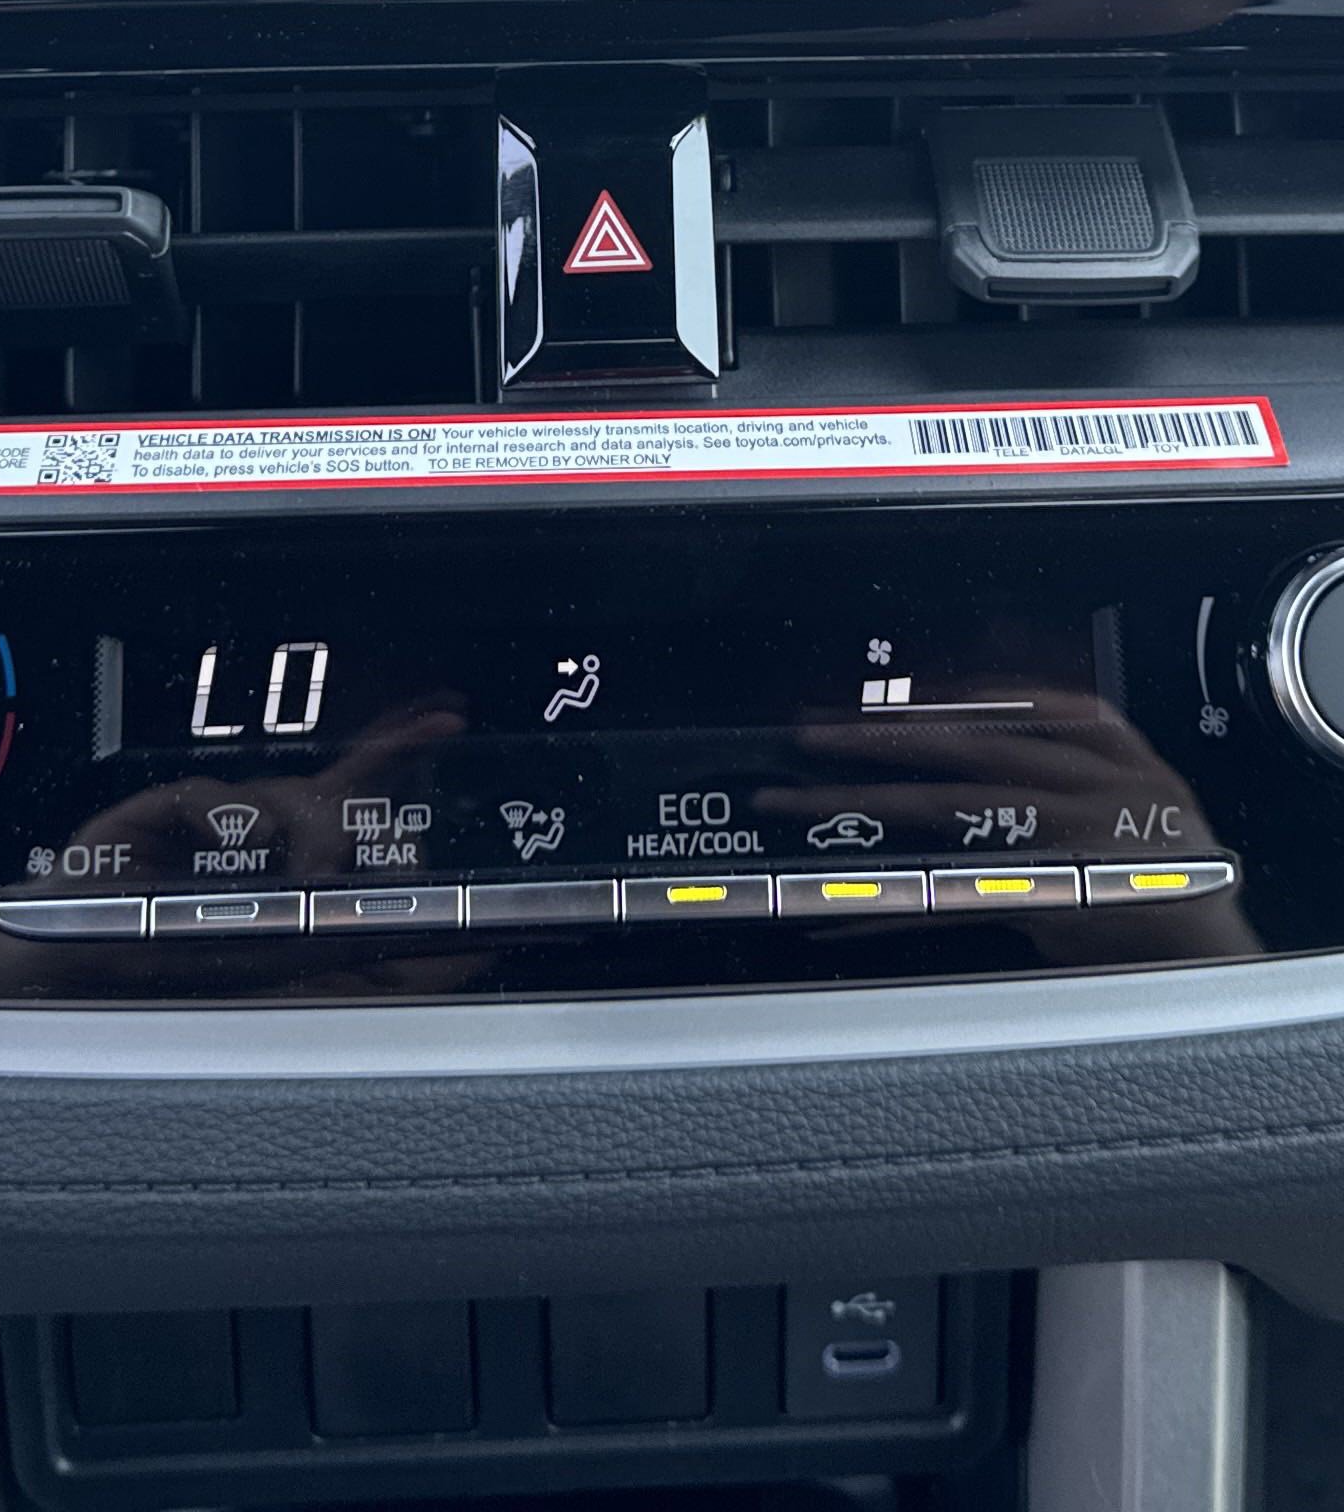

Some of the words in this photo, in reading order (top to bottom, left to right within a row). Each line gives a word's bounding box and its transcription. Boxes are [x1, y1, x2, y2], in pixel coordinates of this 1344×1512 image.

[138, 432, 208, 446] VEHICLE
[212, 431, 256, 444] DATA
[260, 428, 383, 443] TRANSMISSION
[388, 428, 403, 441] IS
[408, 427, 436, 441] ON!
[442, 428, 474, 439] Your
[478, 427, 527, 438] vehicle
[532, 425, 601, 438] wirelessly
[605, 423, 669, 436] transmits
[674, 421, 733, 435] location,
[737, 421, 783, 435] driving
[789, 420, 815, 431] and
[819, 419, 868, 431] vehicle
[134, 449, 177, 461] health
[183, 447, 215, 460] data
[220, 448, 232, 459] to
[239, 446, 287, 459] deliver
[291, 448, 323, 462] your
[327, 445, 386, 457] services
[391, 444, 418, 456] and
[422, 443, 441, 455] for
[446, 442, 499, 454] internal
[504, 441, 565, 453] research
[570, 439, 596, 451] and
[601, 439, 632, 450] data
[637, 437, 698, 452] analysis.
[703, 436, 731, 448] See
[735, 433, 892, 450] toyota.com/privacyvts.
[993, 448, 1029, 457] TELE
[1153, 443, 1180, 453] TOY
[132, 464, 148, 477] To
[152, 462, 208, 477] disable,
[214, 464, 254, 478] press
[259, 461, 321, 474] vehicle's
[326, 459, 360, 472] SOS
[364, 459, 414, 472] button.
[429, 458, 448, 470] TO
[452, 457, 471, 469] BE
[475, 456, 548, 468] REMOVED
[553, 455, 571, 467] BY
[575, 454, 630, 466] OWNER
[634, 453, 671, 465] ONLY
[659, 792, 731, 825] ECO
[1114, 805, 1183, 840] A/C
[357, 843, 418, 866] REAR
[628, 831, 764, 857] HEAT/COOL
[63, 843, 131, 877] OFF
[194, 849, 269, 873] FRONT
